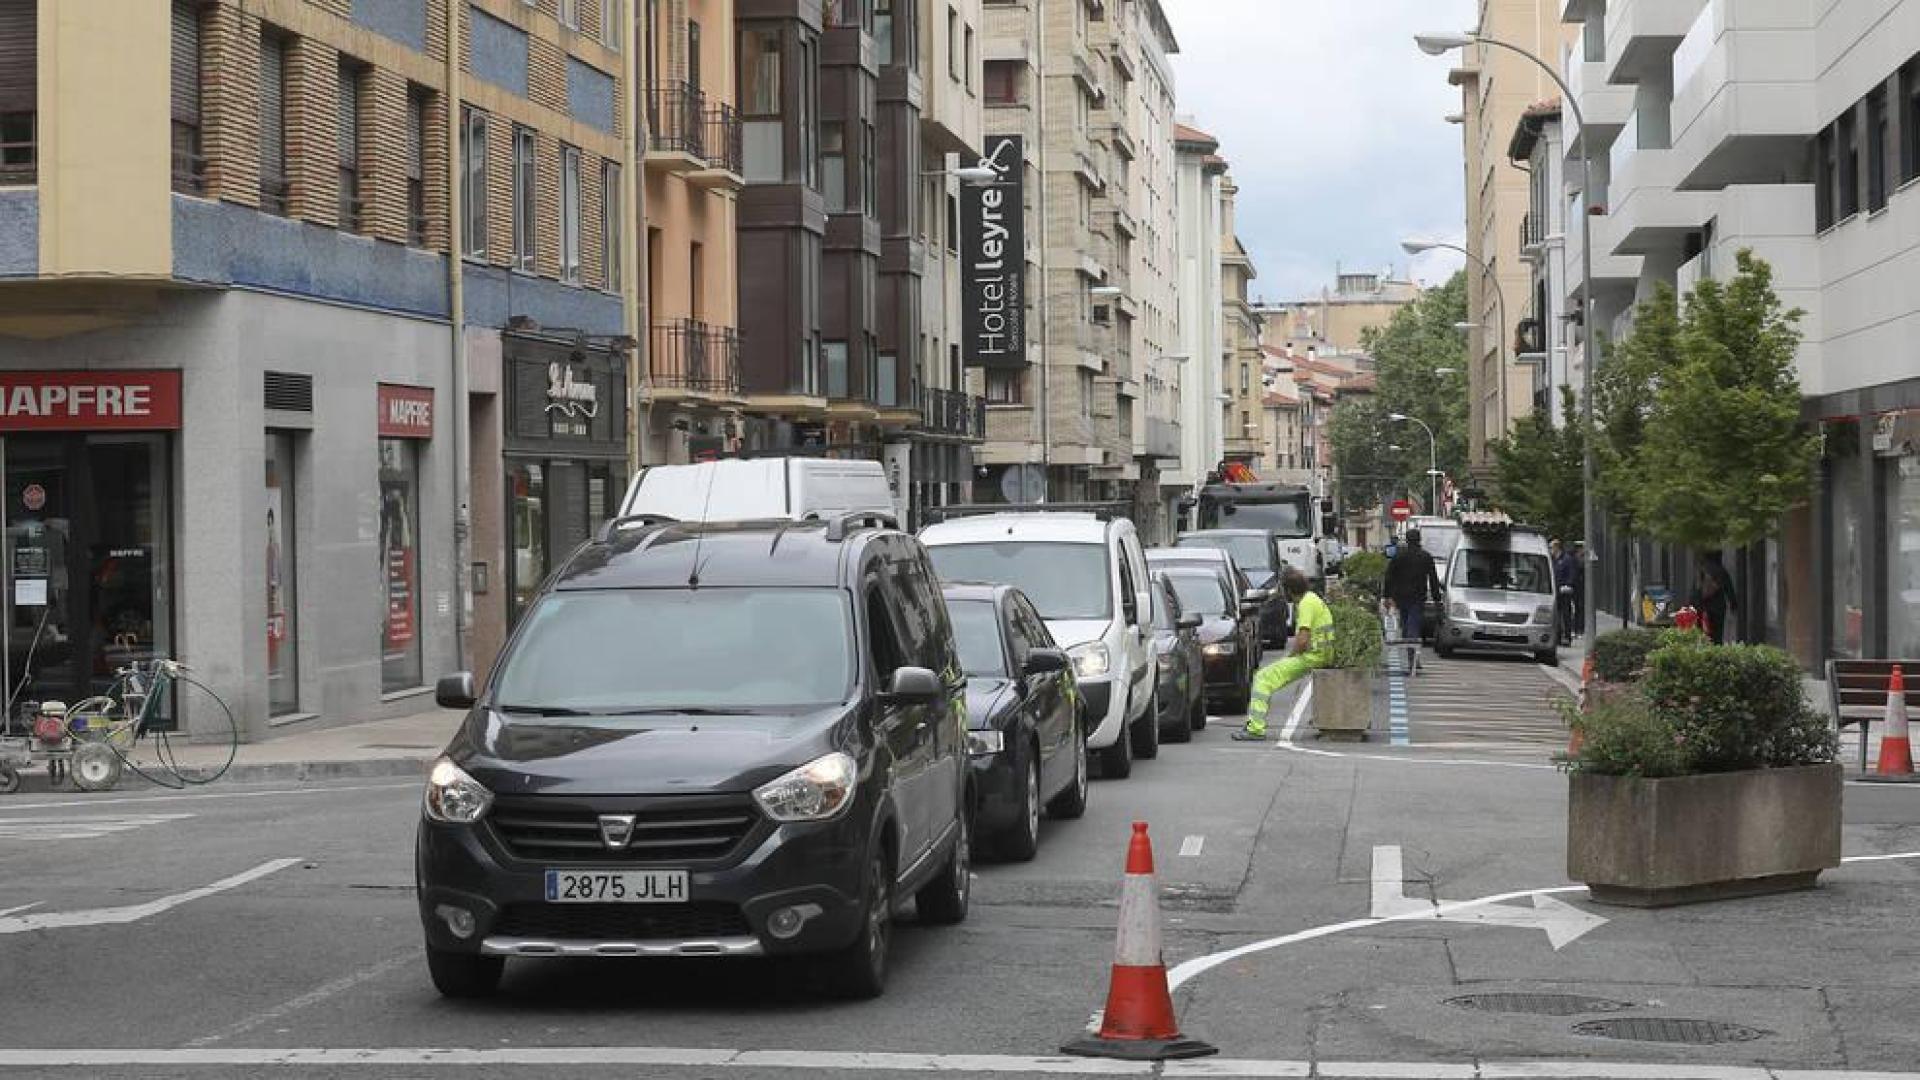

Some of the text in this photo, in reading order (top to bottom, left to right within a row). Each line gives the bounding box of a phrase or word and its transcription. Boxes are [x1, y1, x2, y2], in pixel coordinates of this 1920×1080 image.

[974, 189, 1009, 354] Hotel leyre
[0, 385, 151, 416] APFRE
[390, 398, 431, 427] MAPFRE
[563, 874, 683, 899] 2875 JLH
